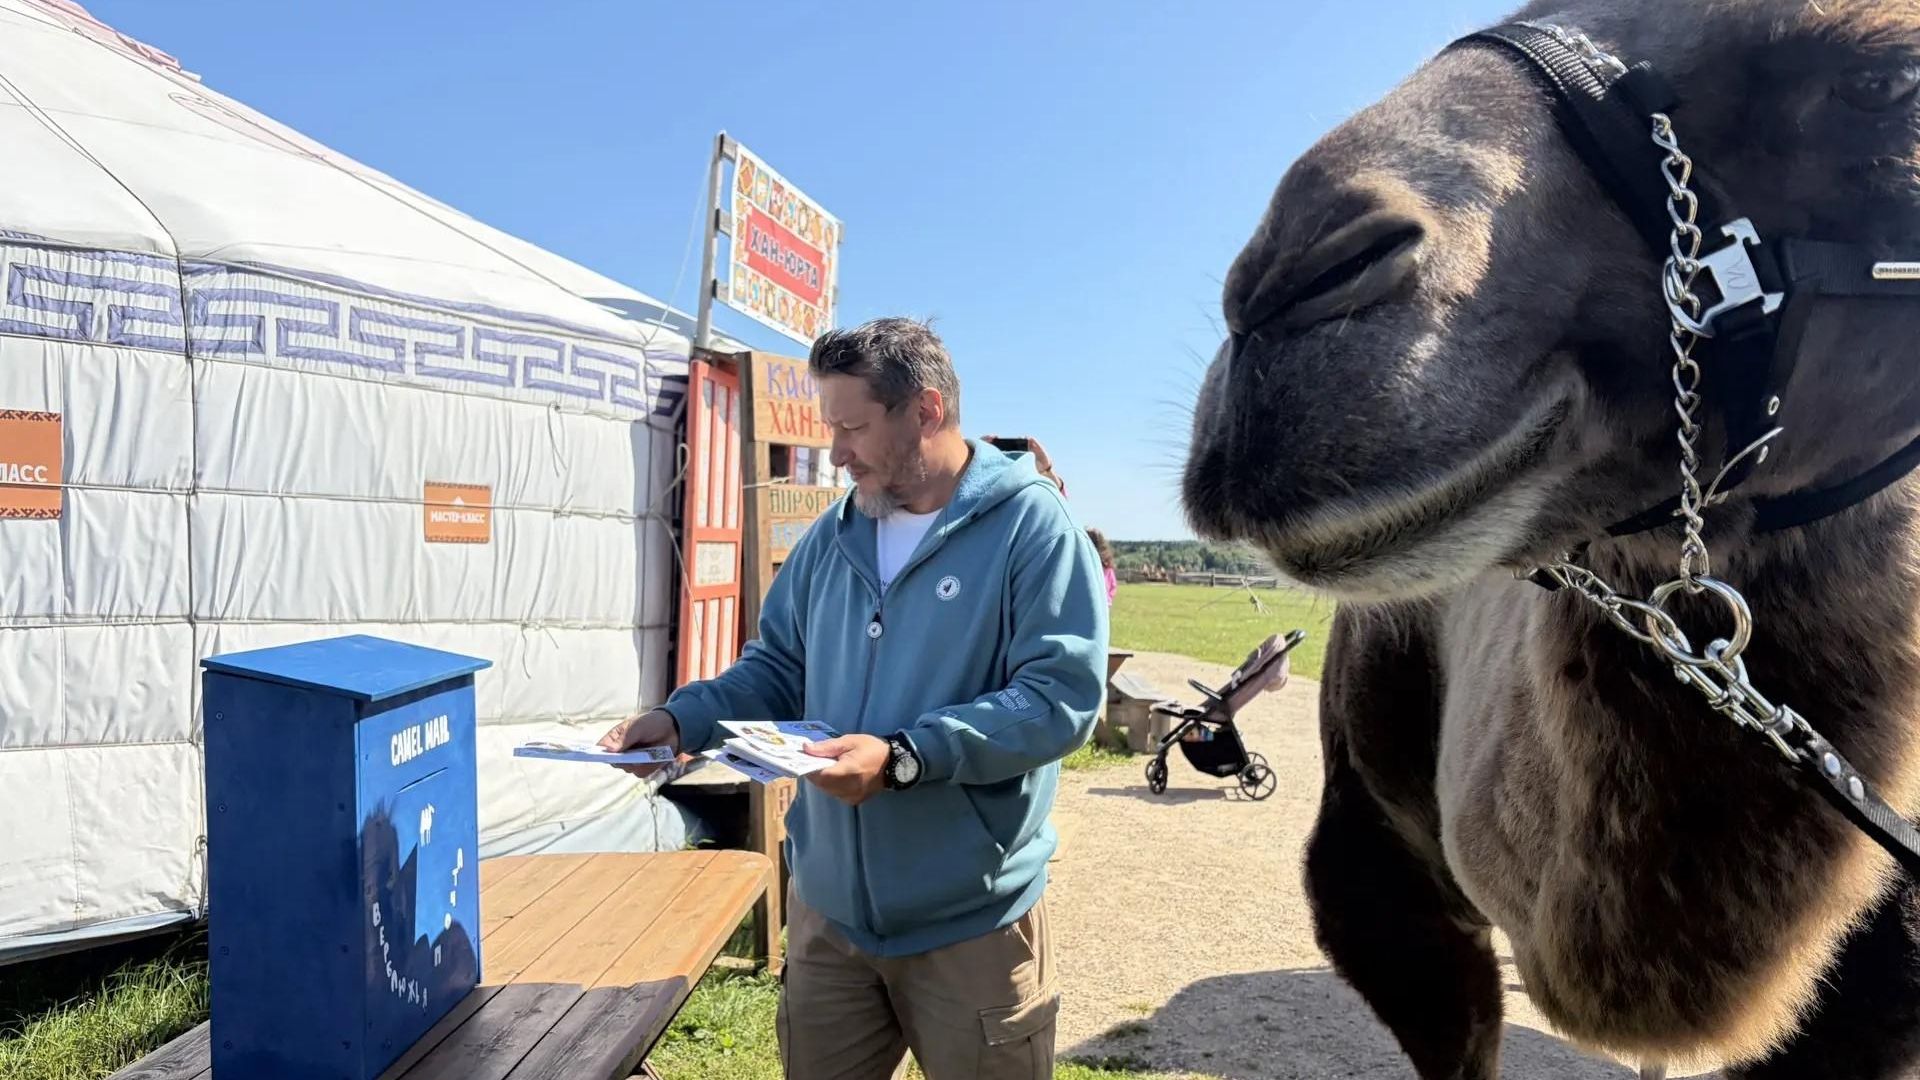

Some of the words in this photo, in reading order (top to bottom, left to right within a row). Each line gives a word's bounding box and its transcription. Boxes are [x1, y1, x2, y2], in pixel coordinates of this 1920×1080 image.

[750, 225, 820, 291] ХАН-ЮРТА
[391, 724, 424, 766] CAMEL
[425, 714, 450, 751] MAIL
[434, 847, 464, 967] ПОЧТА
